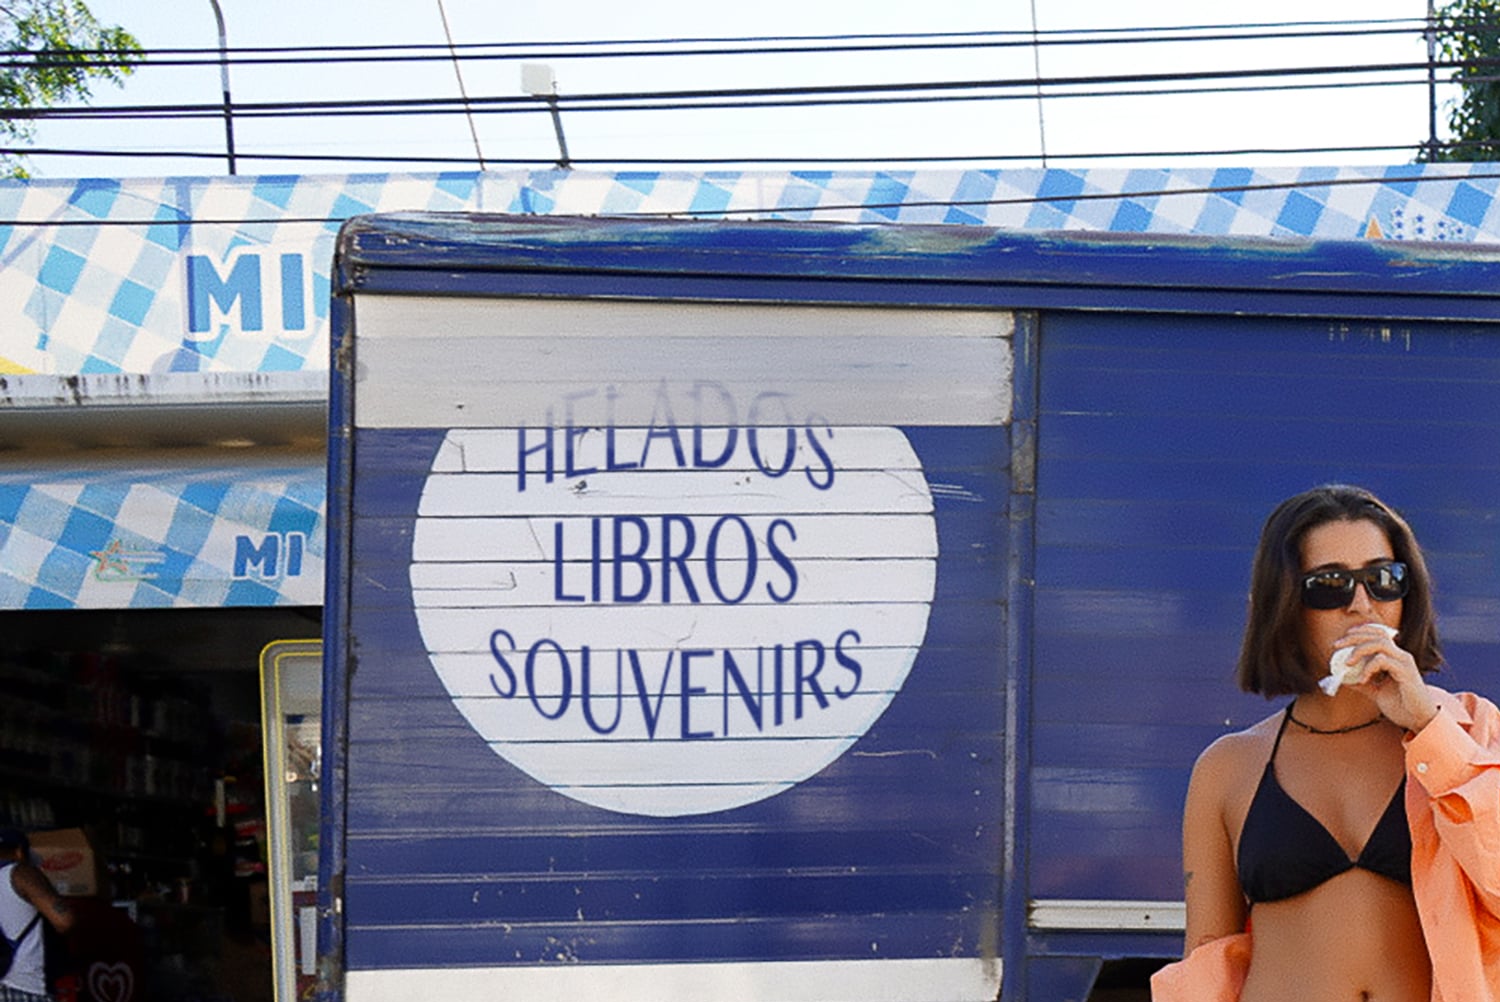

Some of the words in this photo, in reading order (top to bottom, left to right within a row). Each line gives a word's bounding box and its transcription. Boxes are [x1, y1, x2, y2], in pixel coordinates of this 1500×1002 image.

[517, 378, 835, 492] HELADOS
[554, 514, 798, 605] LIBROS
[489, 628, 863, 741] SOUVENIRS
